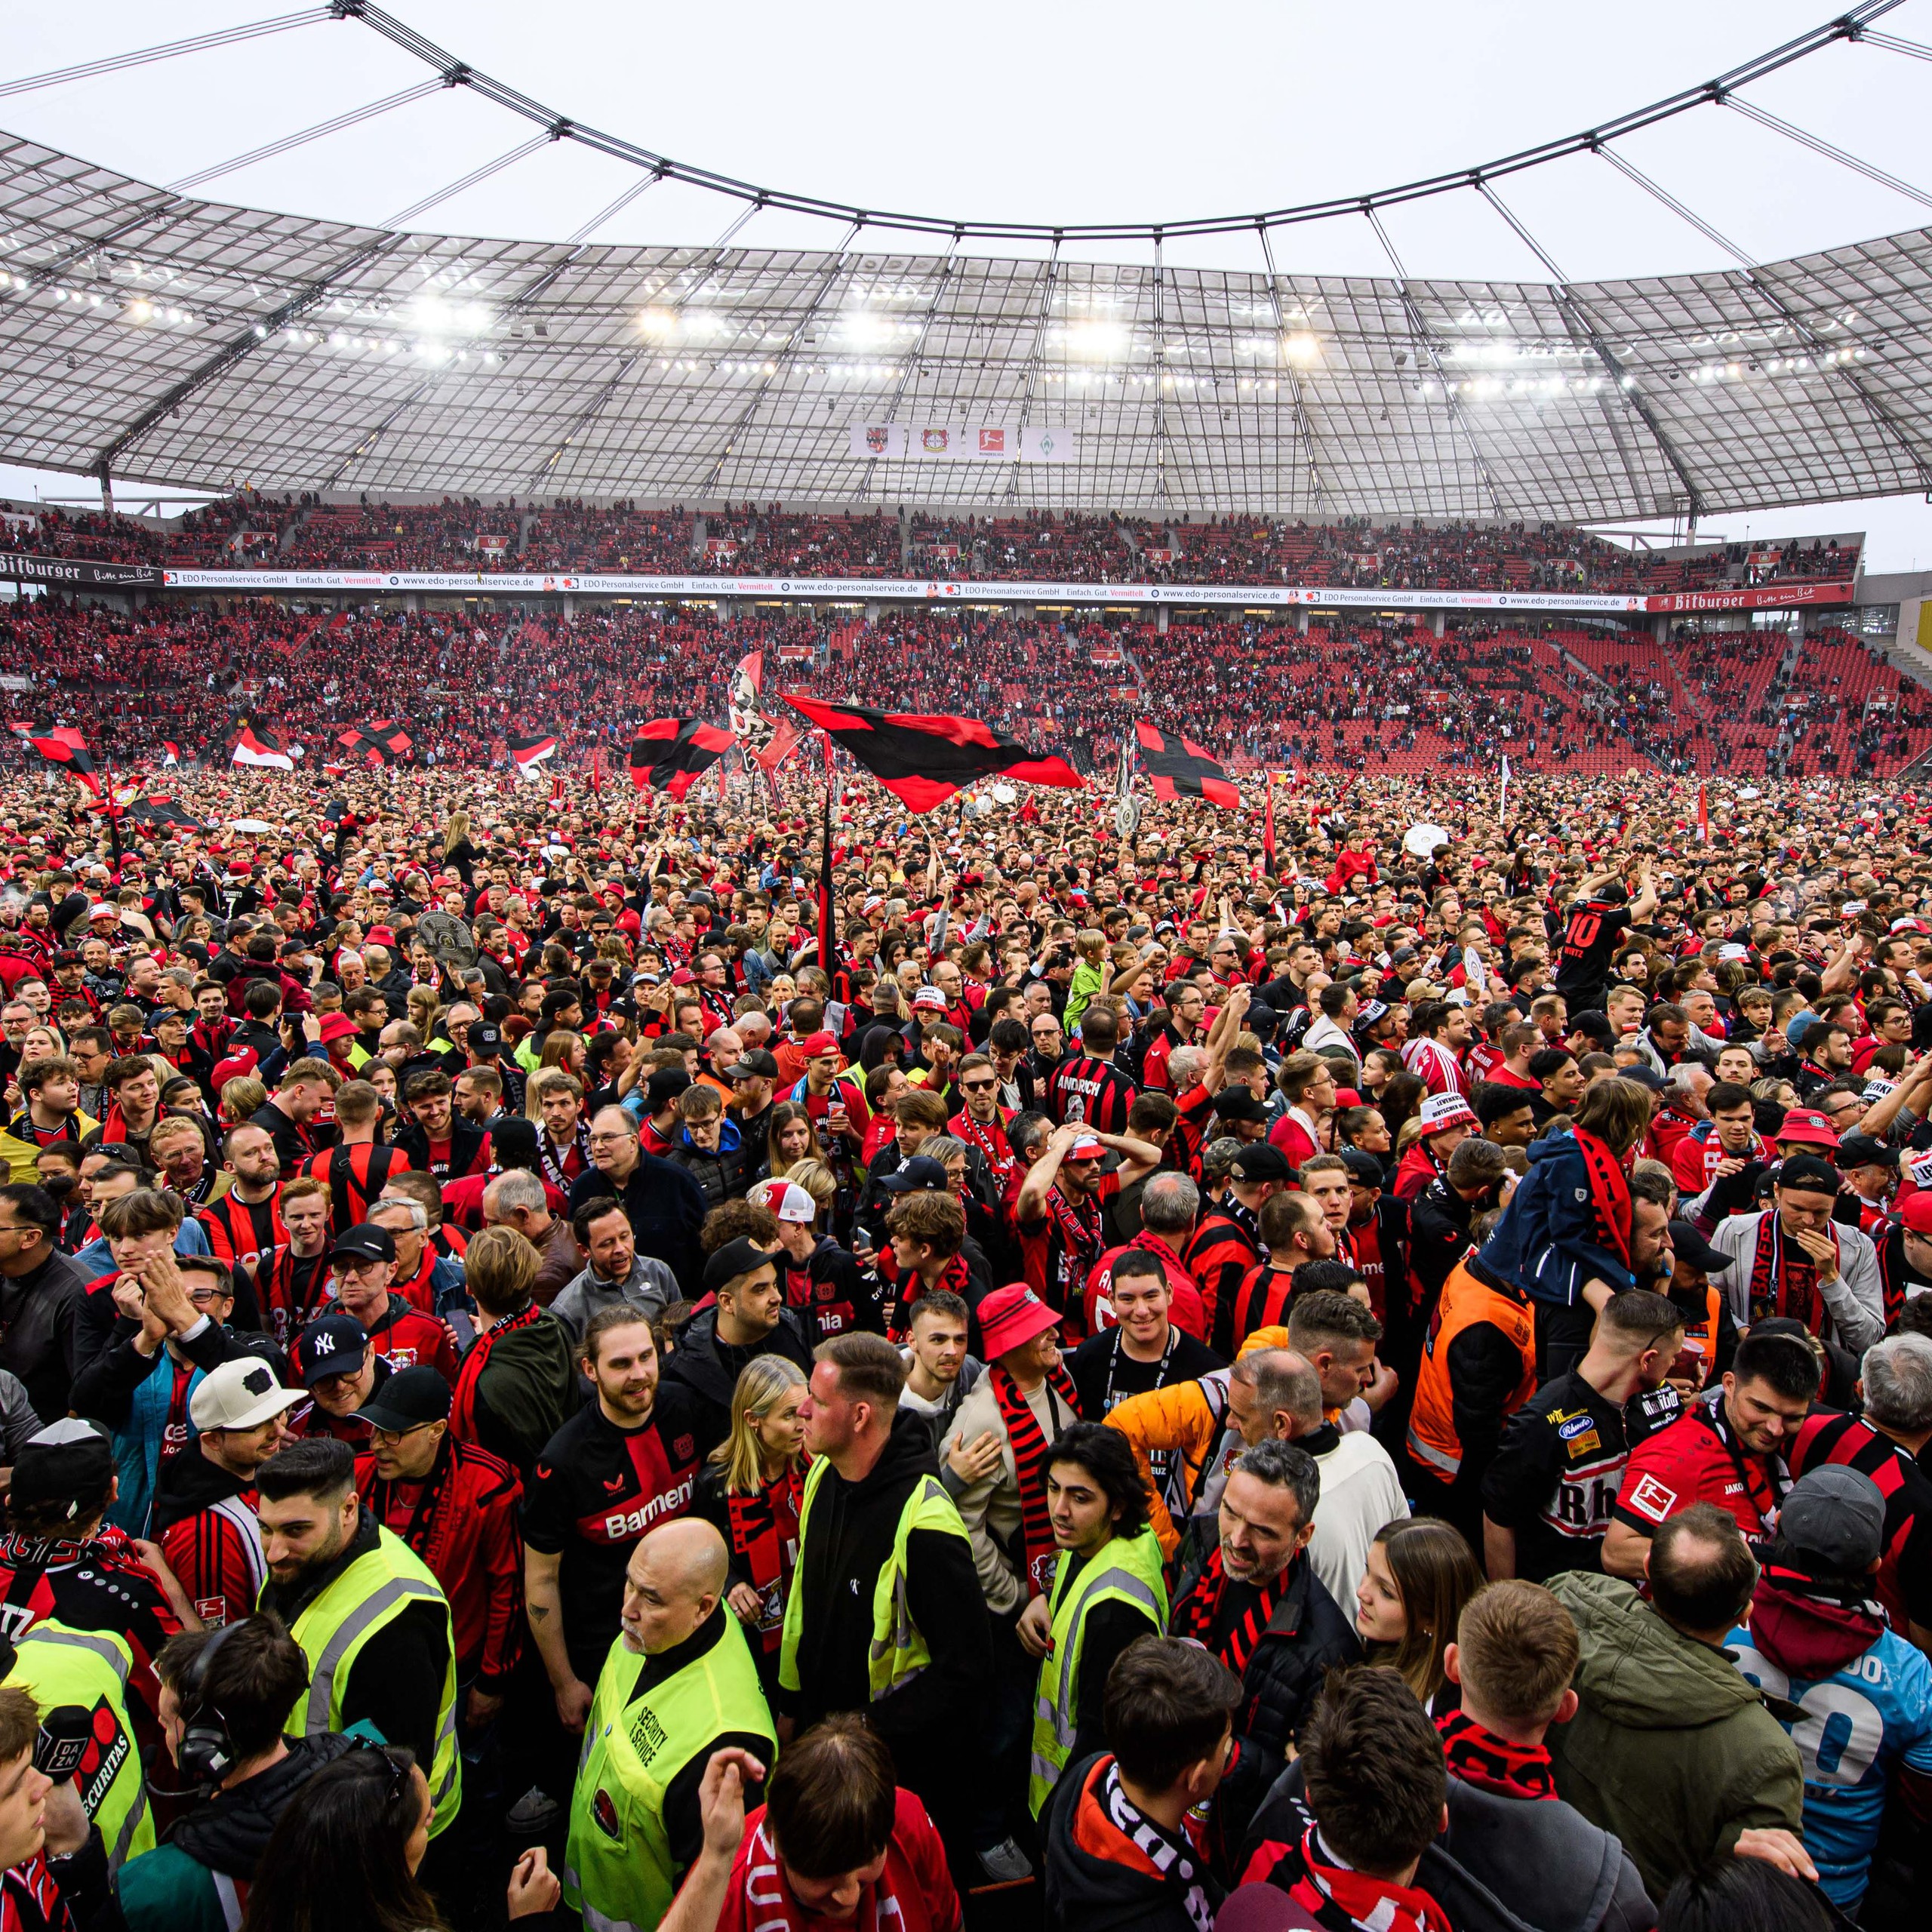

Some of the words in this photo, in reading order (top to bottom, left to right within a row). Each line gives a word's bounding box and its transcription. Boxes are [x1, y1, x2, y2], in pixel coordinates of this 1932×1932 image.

[94, 569, 116, 580] Bitte
[136, 568, 154, 578] Bit
[202, 574, 261, 584] Personalservice
[263, 574, 288, 583] GmbH
[295, 575, 325, 584] Einfach.
[326, 577, 342, 585] Gut.
[343, 576, 383, 586] Vermittelt.
[403, 576, 534, 588] www.edo-personalservice.de
[601, 580, 659, 590] Personalservice
[737, 583, 776, 592] Vermittelt.
[794, 583, 918, 593] www.edo-personalservice.de
[981, 587, 1035, 596] Personalservice
[1066, 588, 1093, 596] Einfach.
[1094, 589, 1109, 597] Gut.
[1110, 589, 1146, 597] Vermittelt.
[1163, 589, 1280, 599] www.edo-personalservice.de
[1340, 595, 1391, 603] Personalservice
[1420, 595, 1444, 604] Einfach.
[1510, 597, 1620, 607] www.edo-personalservice.de
[1674, 594, 1745, 611] Bitburger
[1756, 594, 1777, 605] Bitte
[1797, 587, 1814, 597] Bit
[225, 897, 236, 920] 7
[1565, 912, 1601, 948] 10
[1564, 945, 1583, 958] WIRTZ
[1057, 1075, 1101, 1097] ANDRICH
[1448, 1111, 1469, 1124] 2024
[430, 1163, 450, 1174] WIR
[817, 1312, 842, 1334] nia
[315, 1332, 335, 1355] NY
[1217, 1382, 1228, 1404] Canon
[1641, 1391, 1679, 1417] Malibu
[1724, 1481, 1744, 1495] JAKO
[606, 1473, 694, 1539] Barmeni
[1558, 1478, 1618, 1525] Rh
[1633, 1497, 1661, 1518] BUNDESLIGA
[2, 1602, 35, 1643] TZ
[629, 1722, 638, 1737] &
[638, 1706, 669, 1749] SECURITY
[61, 1743, 79, 1755] DA
[631, 1728, 657, 1767] SERVICE
[57, 1755, 73, 1767] ZN
[82, 1734, 128, 1818] ECURITAS
